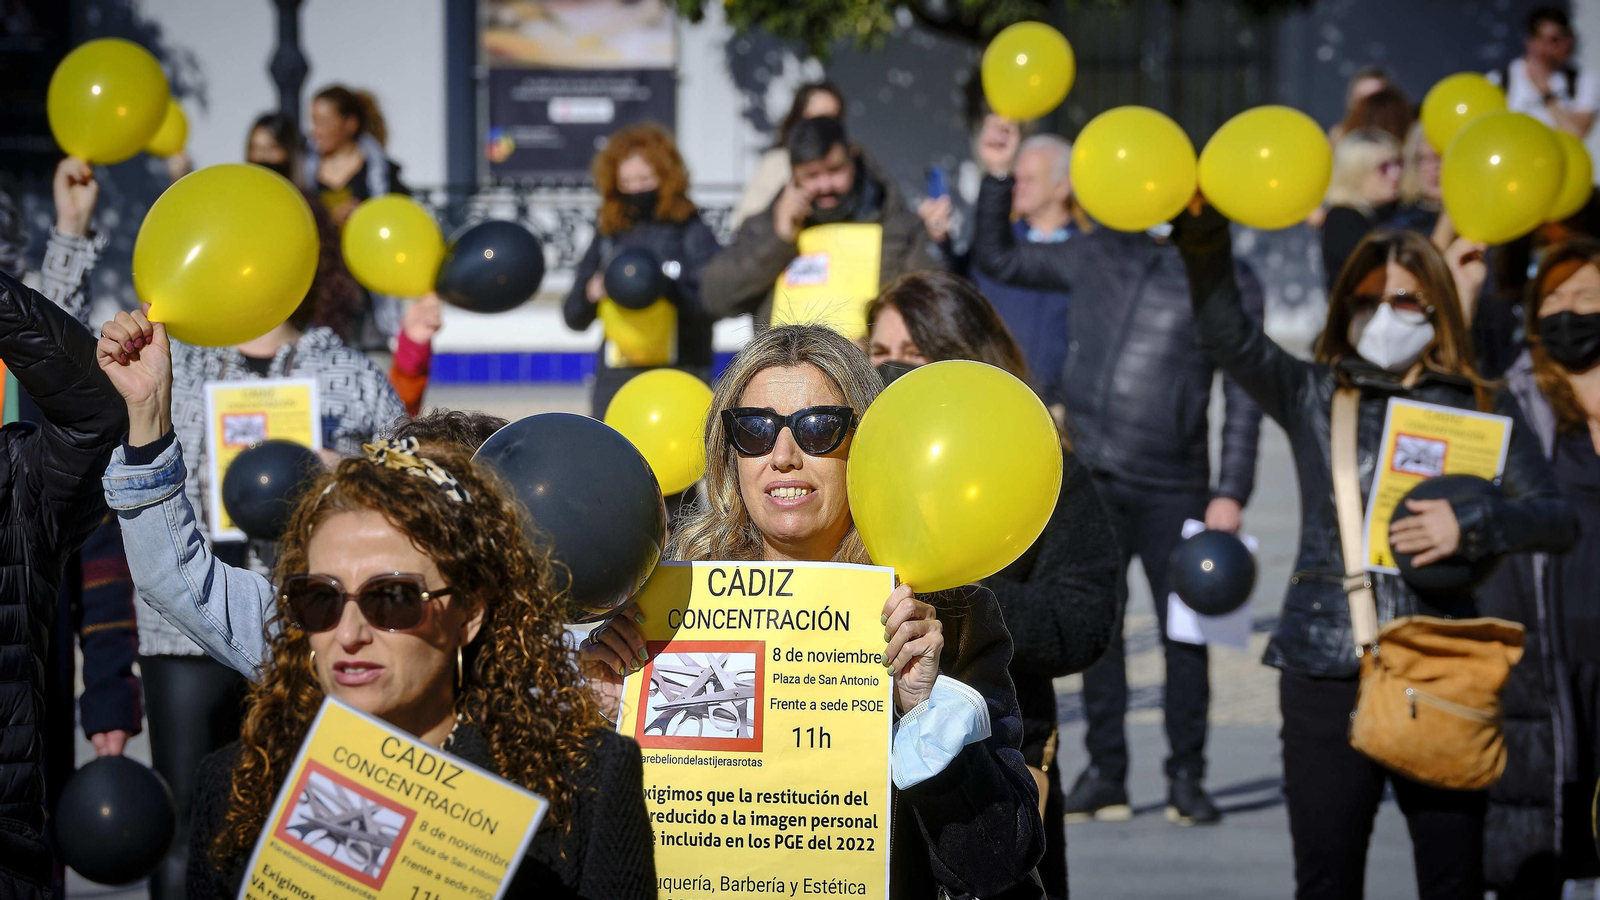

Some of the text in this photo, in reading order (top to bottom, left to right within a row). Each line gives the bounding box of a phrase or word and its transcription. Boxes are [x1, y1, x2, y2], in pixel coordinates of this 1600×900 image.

[668, 606, 850, 631] CONCENTRACIÓN
[773, 647, 882, 664] 8 de noviembre
[773, 673, 879, 686] Plaza de San Antonio
[770, 697, 884, 712] Frente a sede PSOE
[792, 726, 831, 749] 11h
[333, 746, 499, 835] CONCENTRACIÓN
[706, 789, 735, 807] que
[739, 788, 752, 803] la
[756, 789, 840, 805] restitución
[844, 790, 868, 806] del
[419, 820, 429, 832] 8
[430, 826, 446, 840] de
[650, 808, 878, 831] reducido a la imagen personal
[412, 838, 436, 856] Plaza
[437, 851, 449, 861] de
[661, 830, 721, 848] incluida
[725, 836, 744, 848] en
[749, 833, 771, 849] los
[774, 834, 804, 849] PGE
[807, 835, 832, 850] del
[836, 837, 875, 851] 2022
[401, 855, 433, 876] Frente
[444, 875, 468, 892] sede
[720, 876, 785, 893] Barbería
[790, 881, 799, 897] y
[803, 877, 867, 895] Estética
